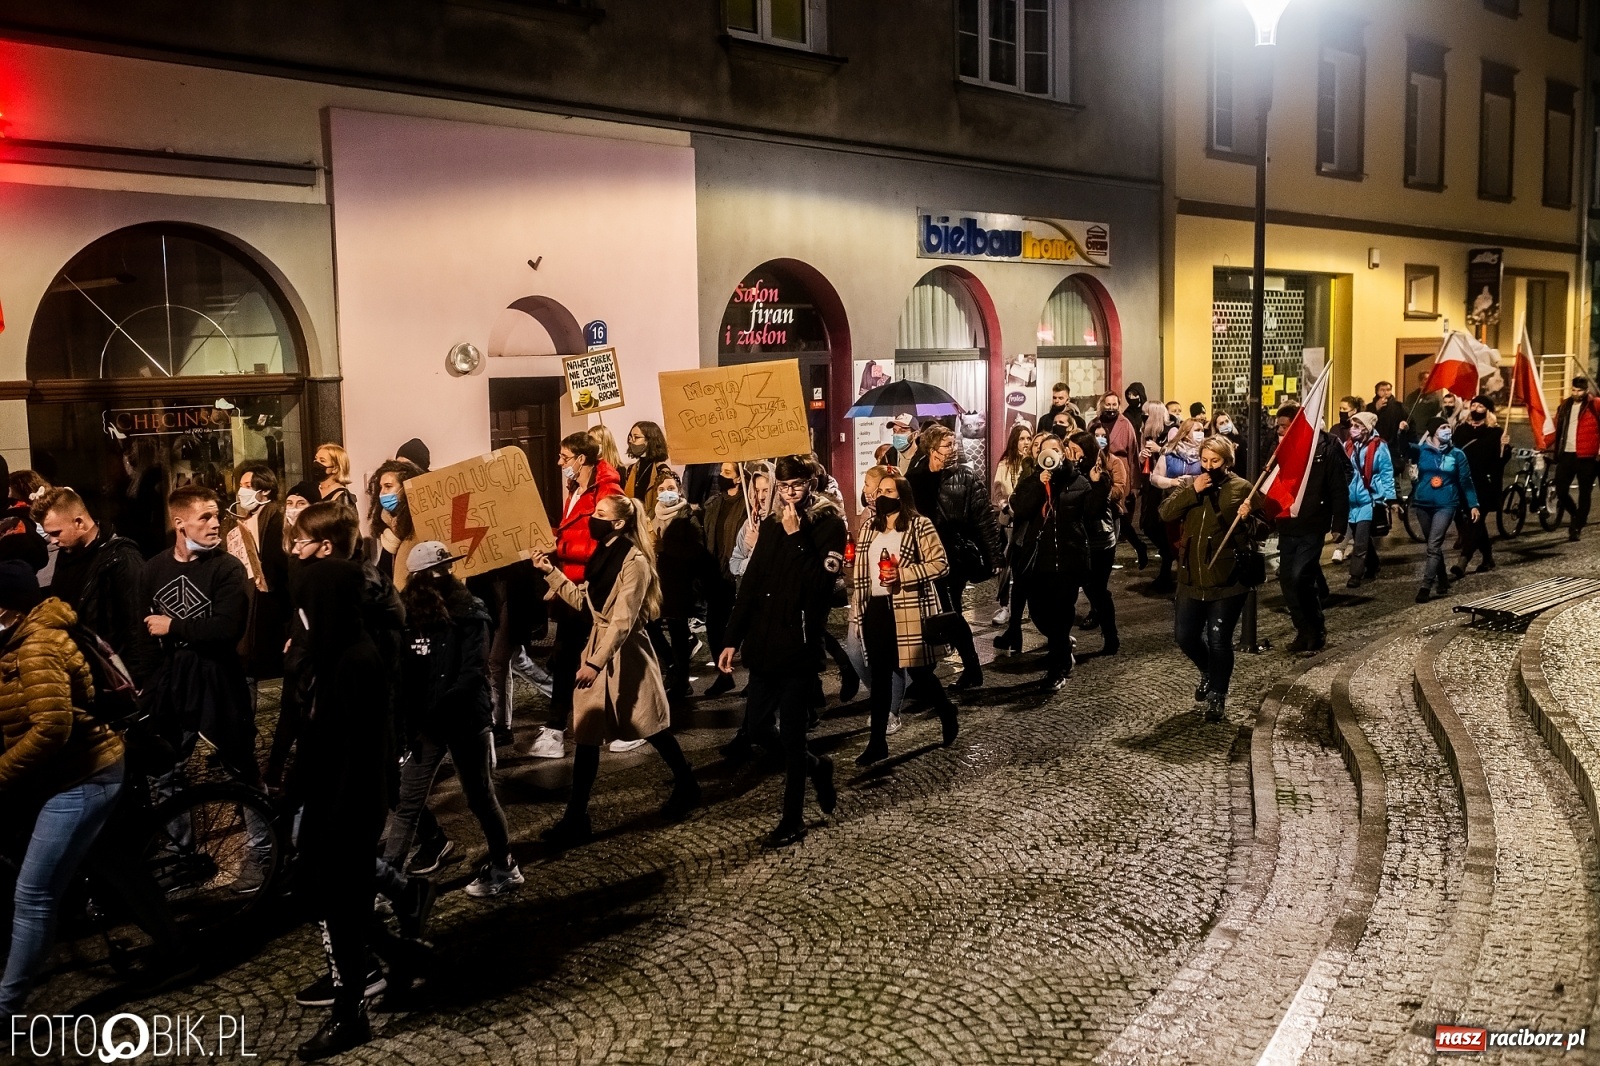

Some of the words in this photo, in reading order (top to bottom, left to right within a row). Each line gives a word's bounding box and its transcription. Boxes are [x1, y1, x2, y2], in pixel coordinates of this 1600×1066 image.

[921, 214, 1022, 257] bielbaw
[1023, 230, 1076, 260] home
[734, 279, 779, 302] Salon
[744, 299, 794, 334] firan
[592, 326, 604, 340] 16
[725, 325, 731, 345] i
[737, 322, 787, 345] zasłon
[566, 358, 589, 370] NAWET
[590, 353, 612, 366] SHREK
[569, 370, 580, 381] NIE
[582, 362, 614, 377] CHCIAŁBY
[571, 374, 605, 390] MIESZKAĆ
[606, 371, 616, 381] NA
[597, 380, 617, 391] TAKIM
[598, 389, 620, 402] BAGNIE
[408, 452, 532, 516] REWOLUCJA
[425, 500, 498, 541] JEST
